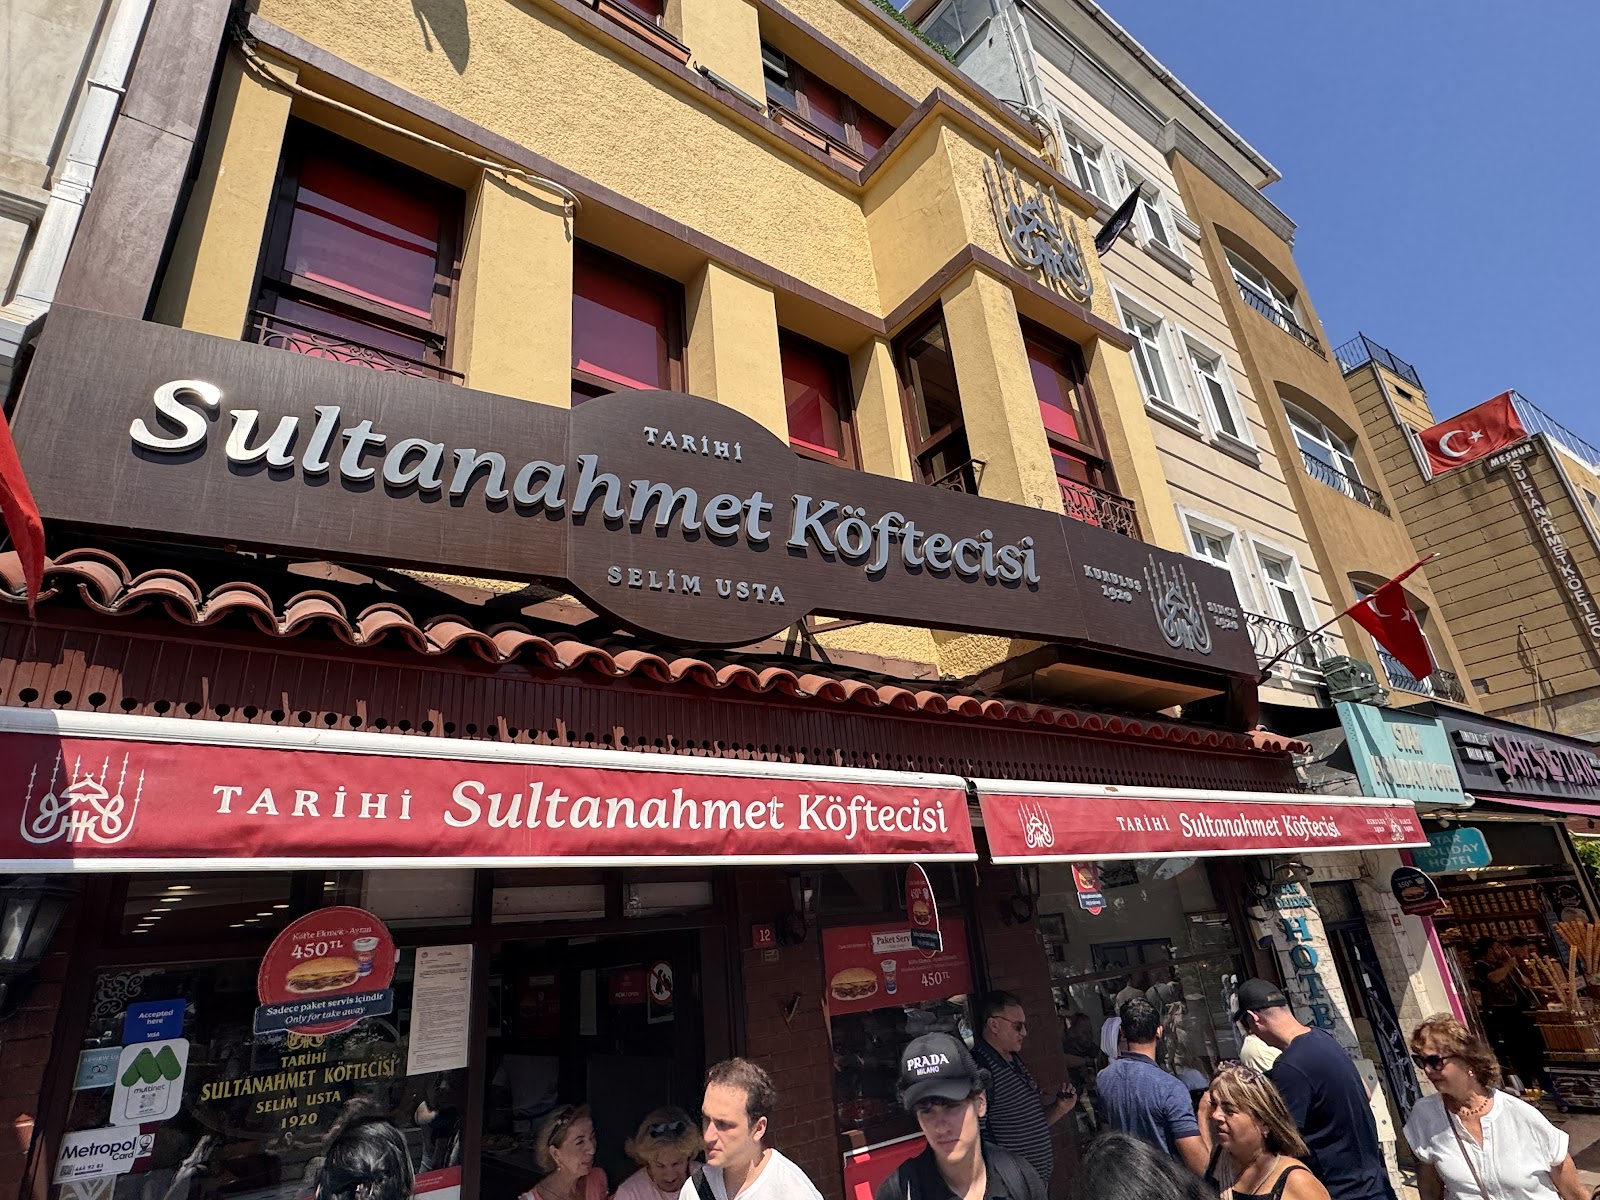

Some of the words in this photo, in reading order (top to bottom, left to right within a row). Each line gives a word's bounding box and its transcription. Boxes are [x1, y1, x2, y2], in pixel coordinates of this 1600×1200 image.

[643, 425, 743, 462] TARİHİ
[129, 379, 774, 542] Sultanahmet
[787, 493, 1041, 584] Köftecisi
[1511, 459, 1568, 565] SULTANAHMET
[607, 564, 702, 596] SELİM
[716, 578, 786, 605] USTA
[1083, 563, 1143, 593] KURULUŞ
[1101, 584, 1133, 603] 1920
[1391, 722, 1423, 750] STAR
[213, 784, 413, 820] TARİHİ
[443, 778, 785, 830] Sultanahmet
[798, 794, 948, 840] Köftecisi
[1116, 813, 1171, 832] TARİHİ
[1179, 812, 1282, 838] Sultanahmet
[1281, 815, 1341, 841] Köftecisi
[1428, 834, 1461, 846] STAR
[1416, 842, 1480, 858] HOLIDAY
[1428, 855, 1476, 868] HOTEL
[759, 928, 771, 942] 12
[876, 936, 895, 945] Paket
[895, 934, 910, 943] Serv
[138, 1009, 174, 1019] Accepted
[266, 1005, 300, 1016] Sadece
[300, 1000, 326, 1013] paket
[327, 996, 354, 1007] servis
[285, 1014, 309, 1025] Only
[308, 1011, 323, 1024] for
[322, 1009, 342, 1019] take
[342, 1007, 366, 1017] away
[281, 1049, 327, 1068] TARİHİ
[907, 1053, 950, 1072] PRADA
[916, 1065, 940, 1076] MILANO
[133, 1083, 166, 1094] multinet
[200, 1069, 317, 1102] SULTANAHMET
[255, 1094, 298, 1114] SELİM
[306, 1090, 342, 1107] USTA
[280, 1111, 318, 1130] 1920
[61, 1136, 137, 1161] Metropol
[112, 1151, 135, 1161] Card
